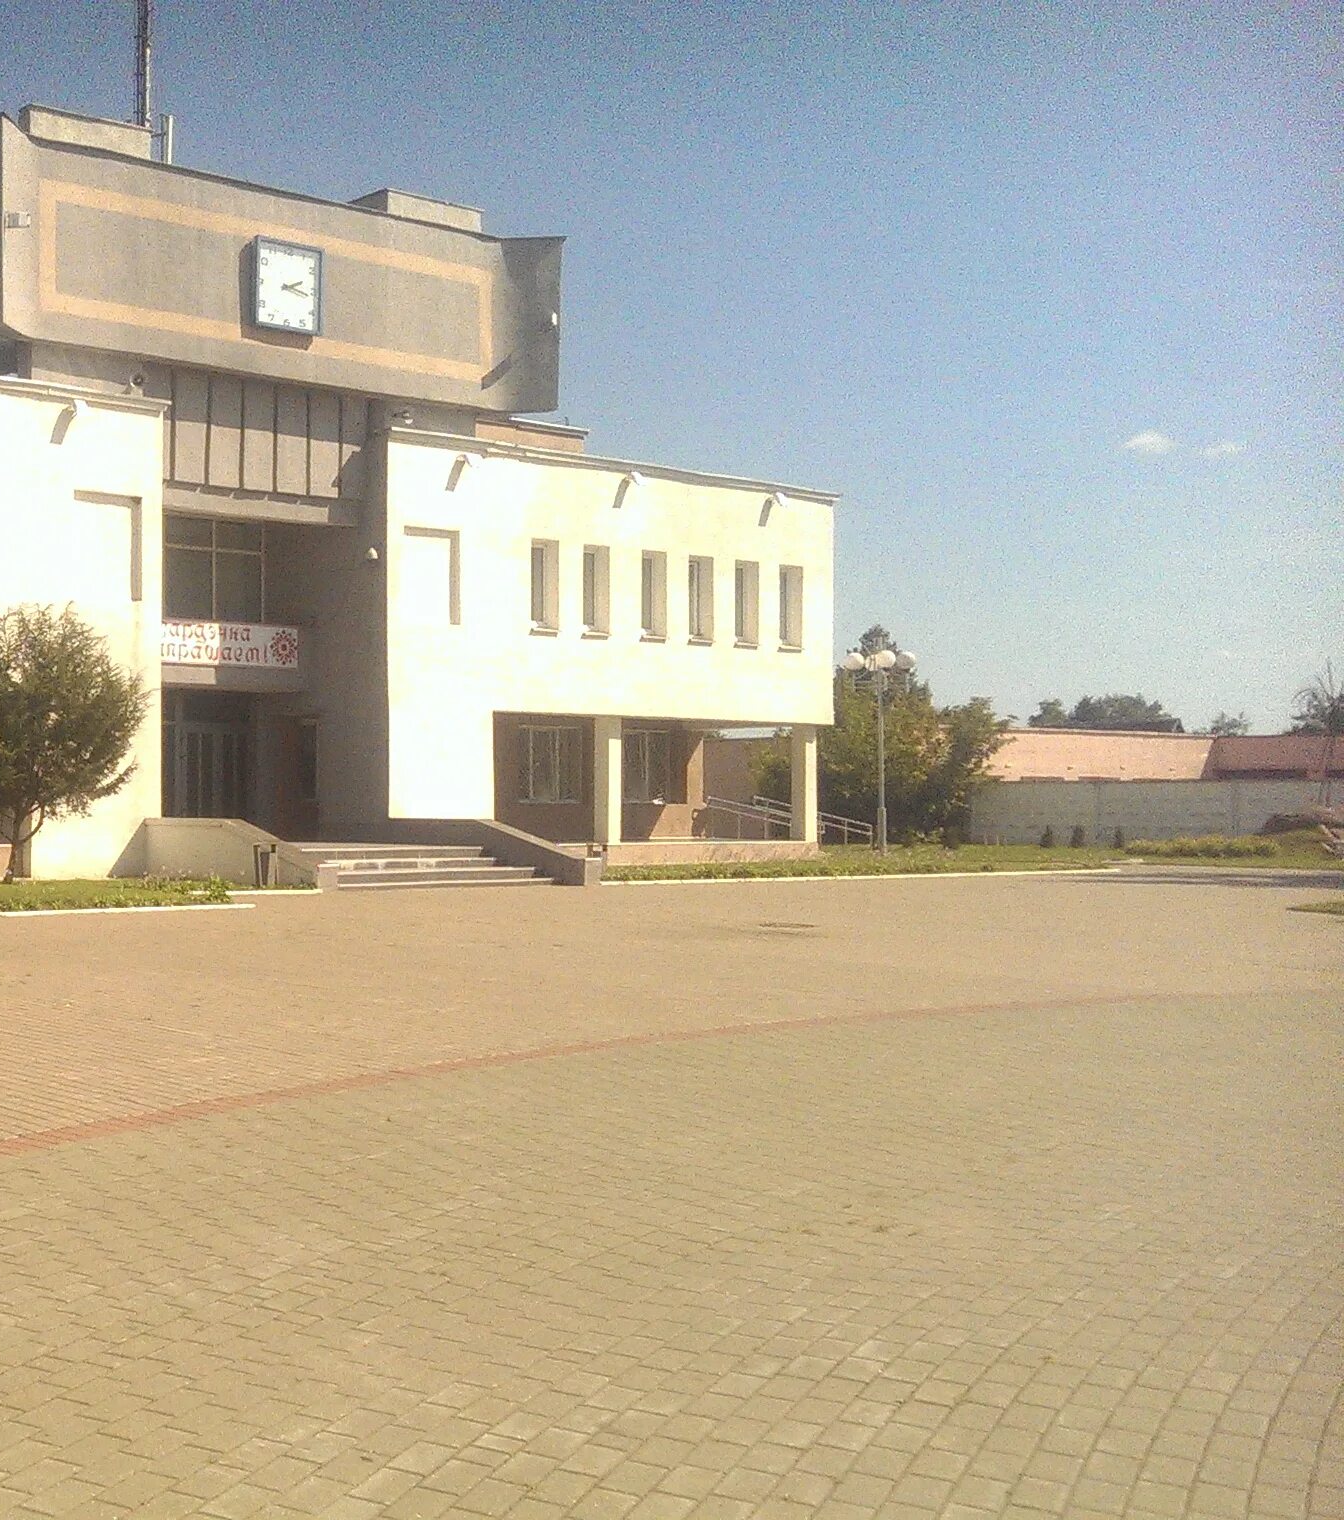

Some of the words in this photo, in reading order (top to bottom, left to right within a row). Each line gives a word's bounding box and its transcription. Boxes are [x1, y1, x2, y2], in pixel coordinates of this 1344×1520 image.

[268, 313, 275, 321] 7
[283, 319, 291, 327] 6
[299, 319, 306, 328] 5
[162, 622, 251, 642] ардэчна
